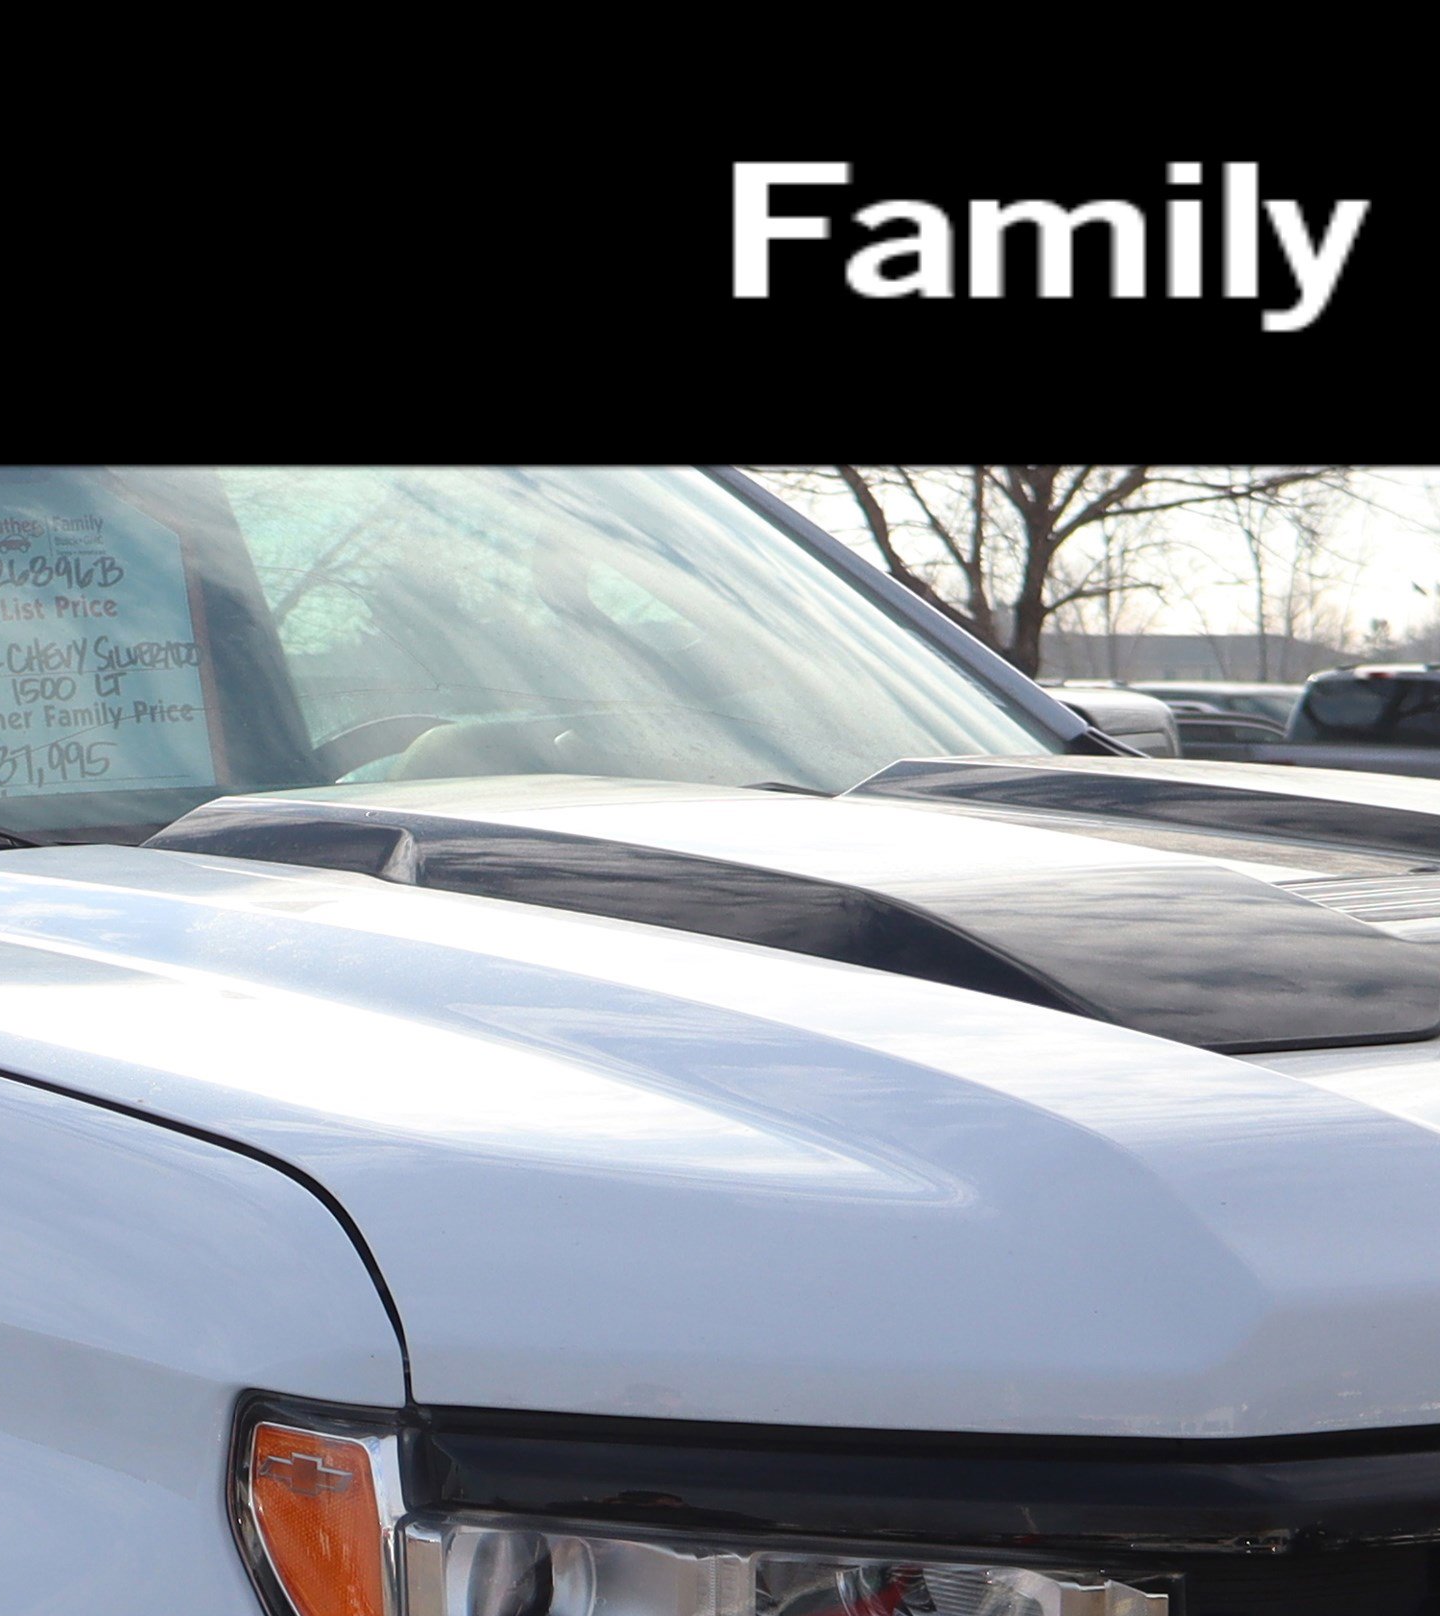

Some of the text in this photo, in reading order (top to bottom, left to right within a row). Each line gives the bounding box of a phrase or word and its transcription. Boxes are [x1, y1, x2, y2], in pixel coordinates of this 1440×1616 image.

[51, 515, 104, 534] Family
[0, 595, 119, 622] List Price
[12, 673, 128, 706] 1500 LT
[44, 702, 122, 729] Family
[133, 699, 196, 724] Price
